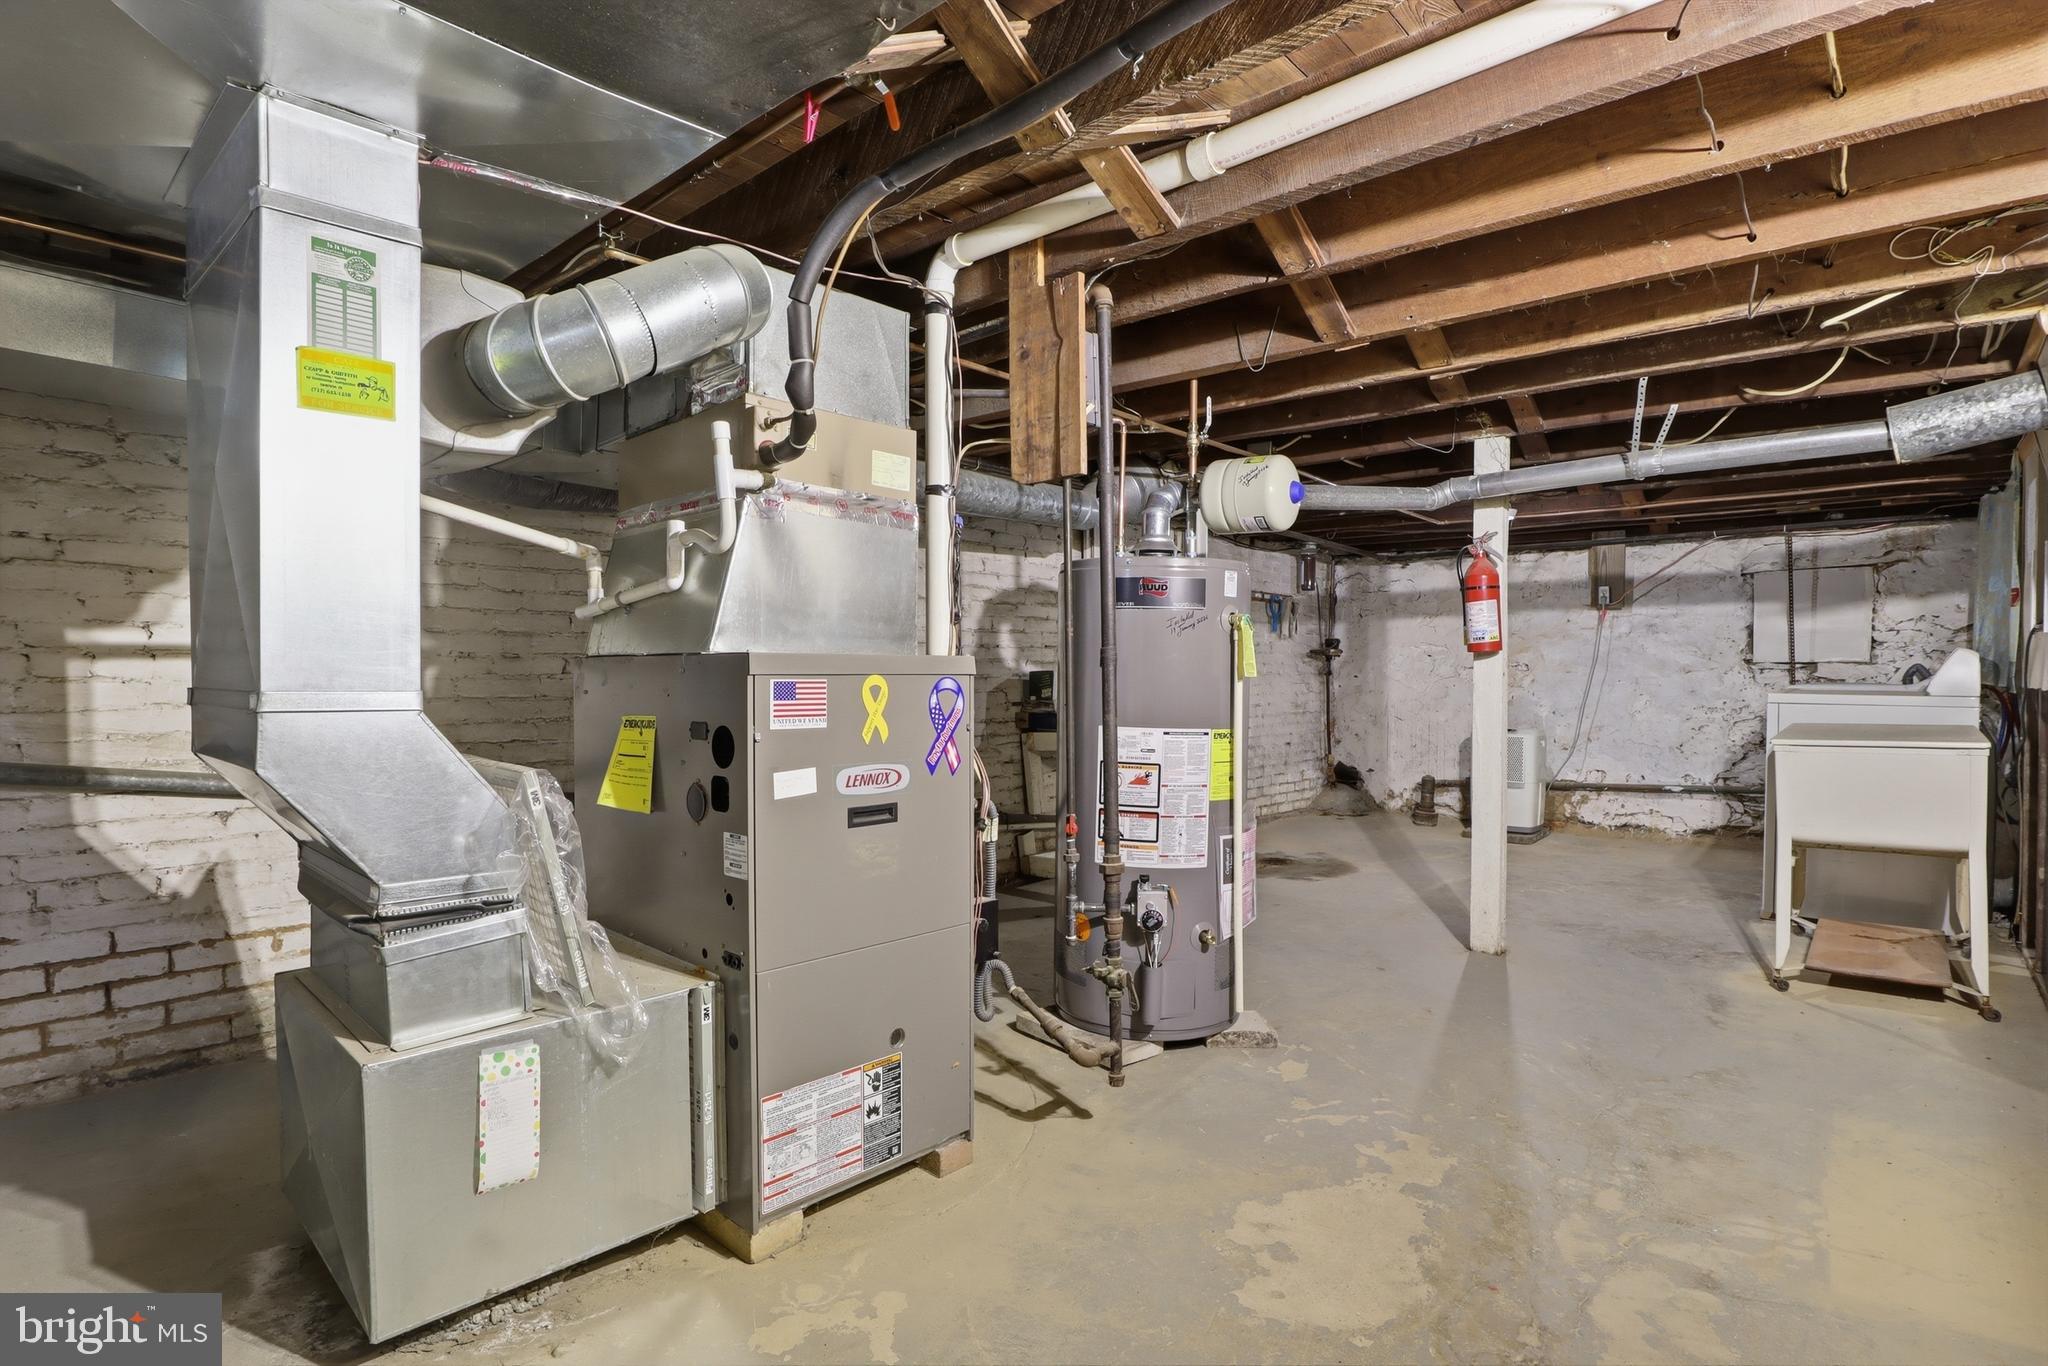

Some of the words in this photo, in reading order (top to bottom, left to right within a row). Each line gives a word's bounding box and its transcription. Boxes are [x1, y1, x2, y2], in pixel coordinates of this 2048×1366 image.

[845, 772, 891, 788] LENNOX
[530, 789, 541, 807] 3M
[703, 1006, 710, 1022] 3M
